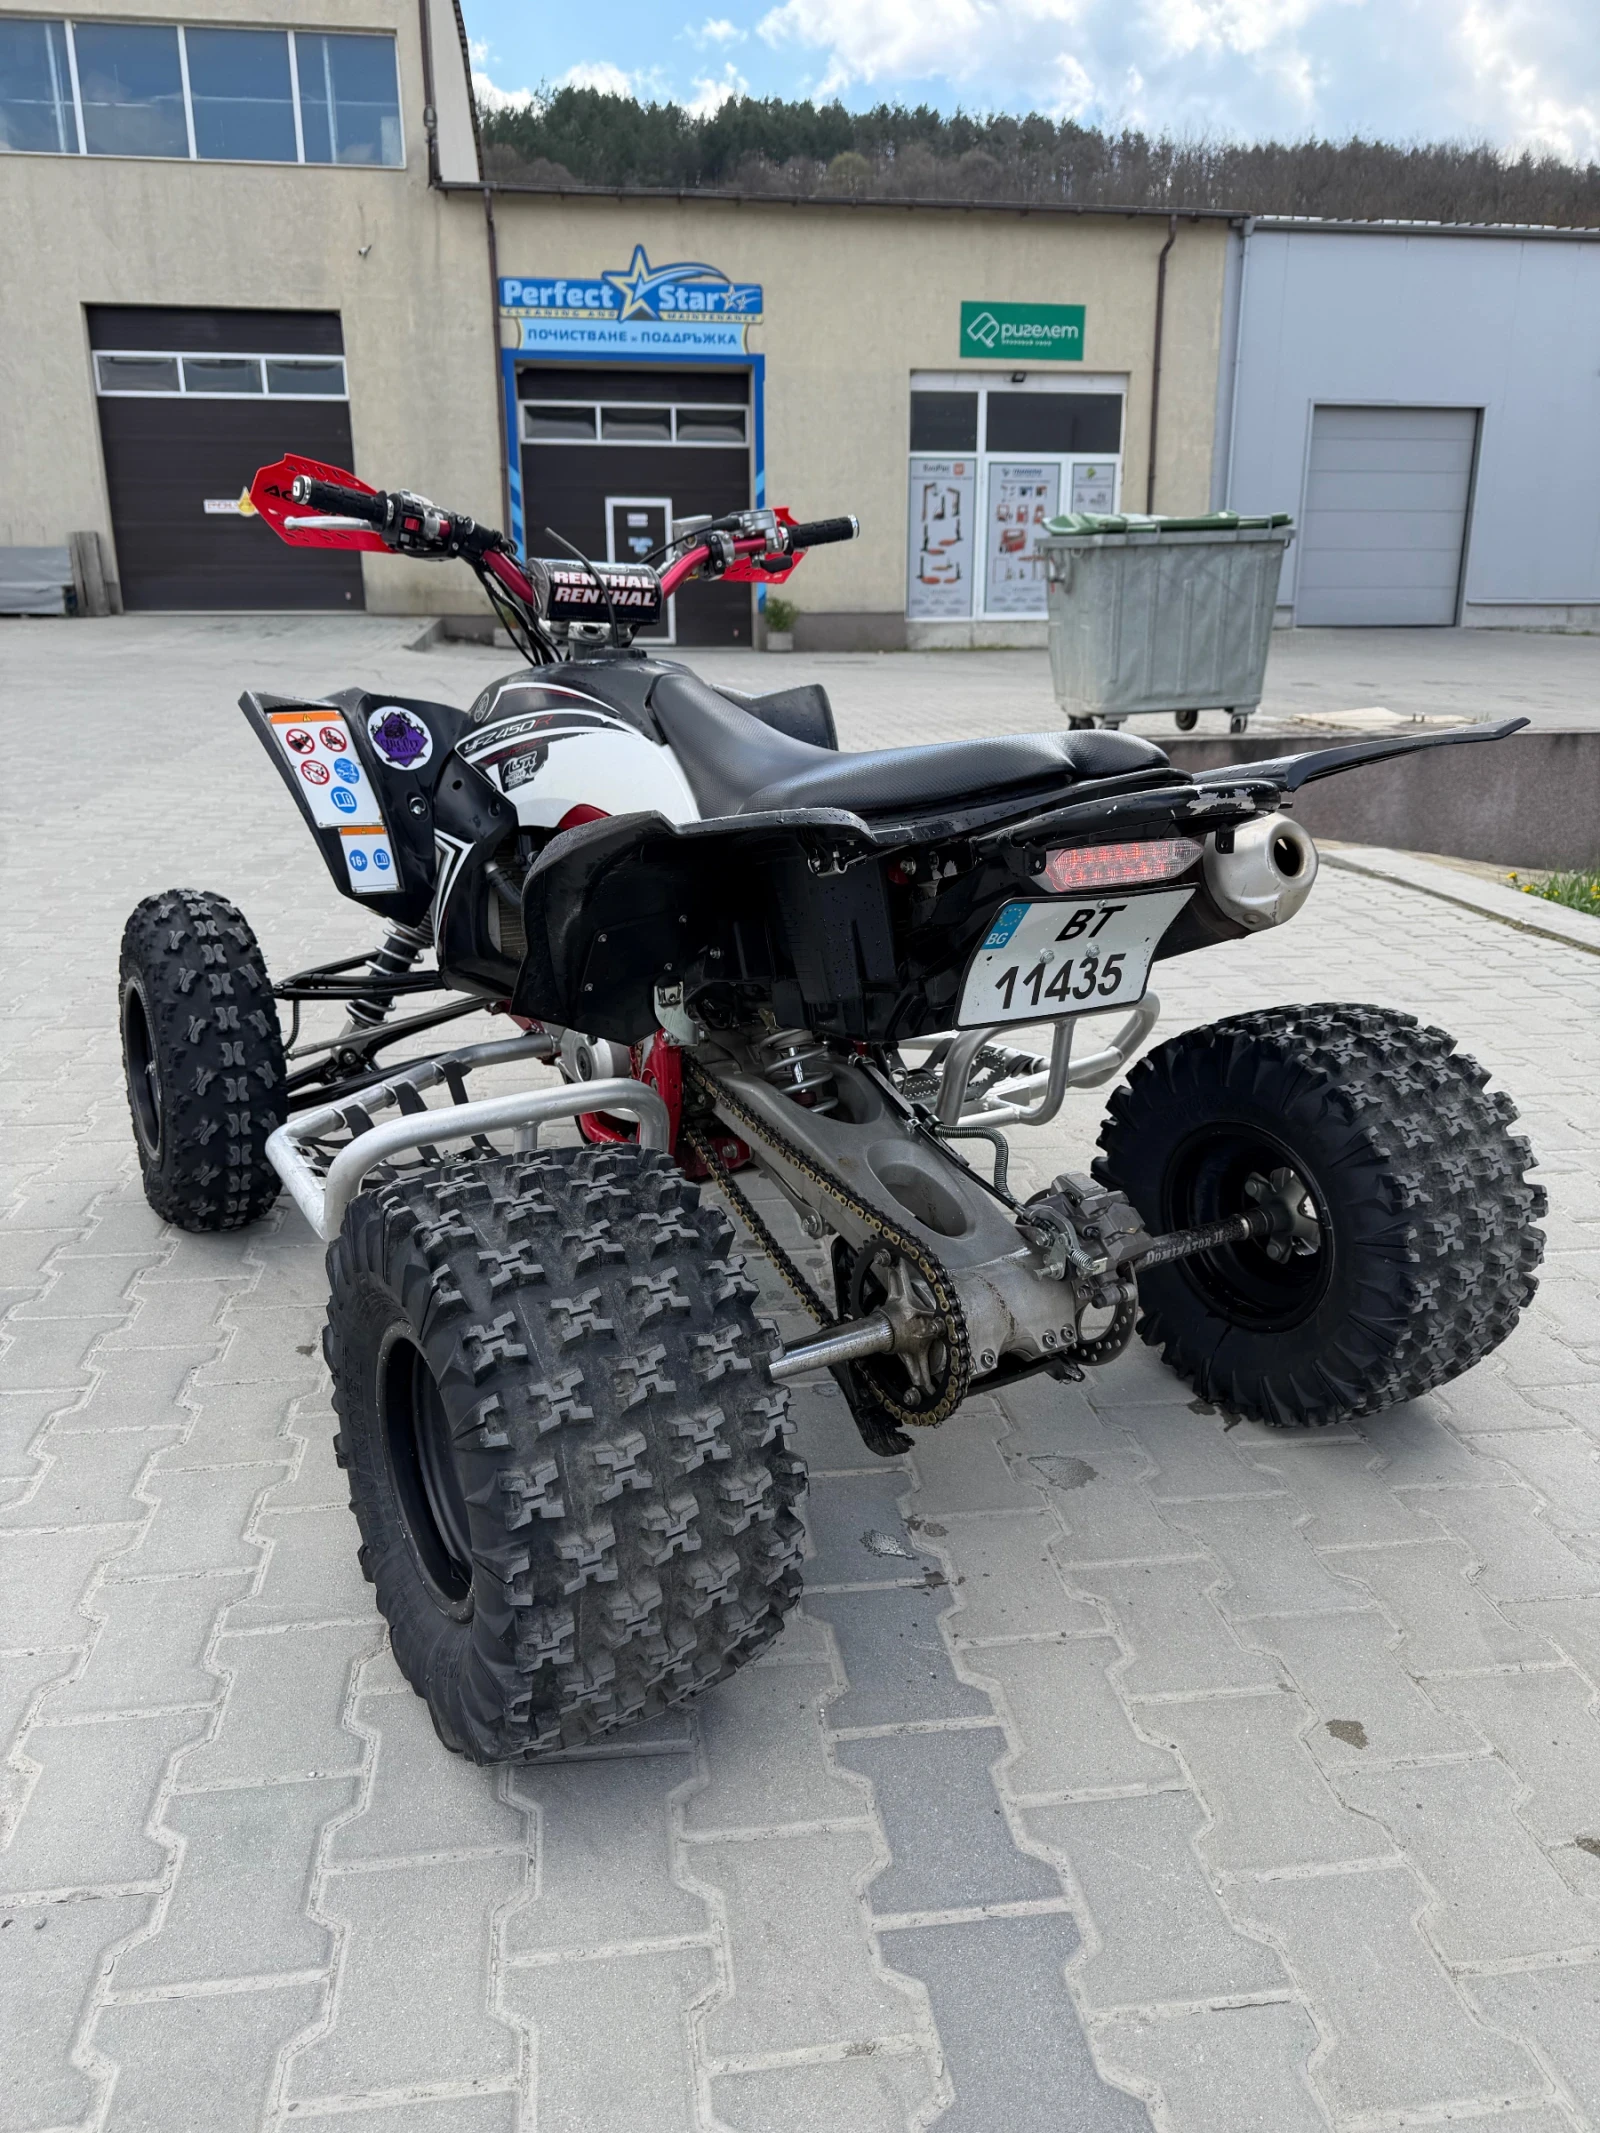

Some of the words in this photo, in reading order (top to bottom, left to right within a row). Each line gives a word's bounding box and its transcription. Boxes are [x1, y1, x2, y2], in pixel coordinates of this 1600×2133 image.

[503, 280, 614, 308] Perfect
[658, 285, 719, 311] Star
[506, 308, 580, 317] CLEANING
[588, 310, 617, 318] AND
[667, 313, 758, 322] MAINTENANCE
[528, 329, 628, 342] ПОЧИСТВАНЕ
[641, 332, 737, 345] ПОДДРЪЖКА
[1001, 323, 1079, 340] ригелет
[554, 571, 655, 589] RENTHAL
[554, 586, 655, 606] RENTHAL
[350, 856, 366, 867] 16+
[1055, 904, 1128, 942] BT
[985, 932, 1008, 946] BG
[994, 953, 1127, 1010] 11435
